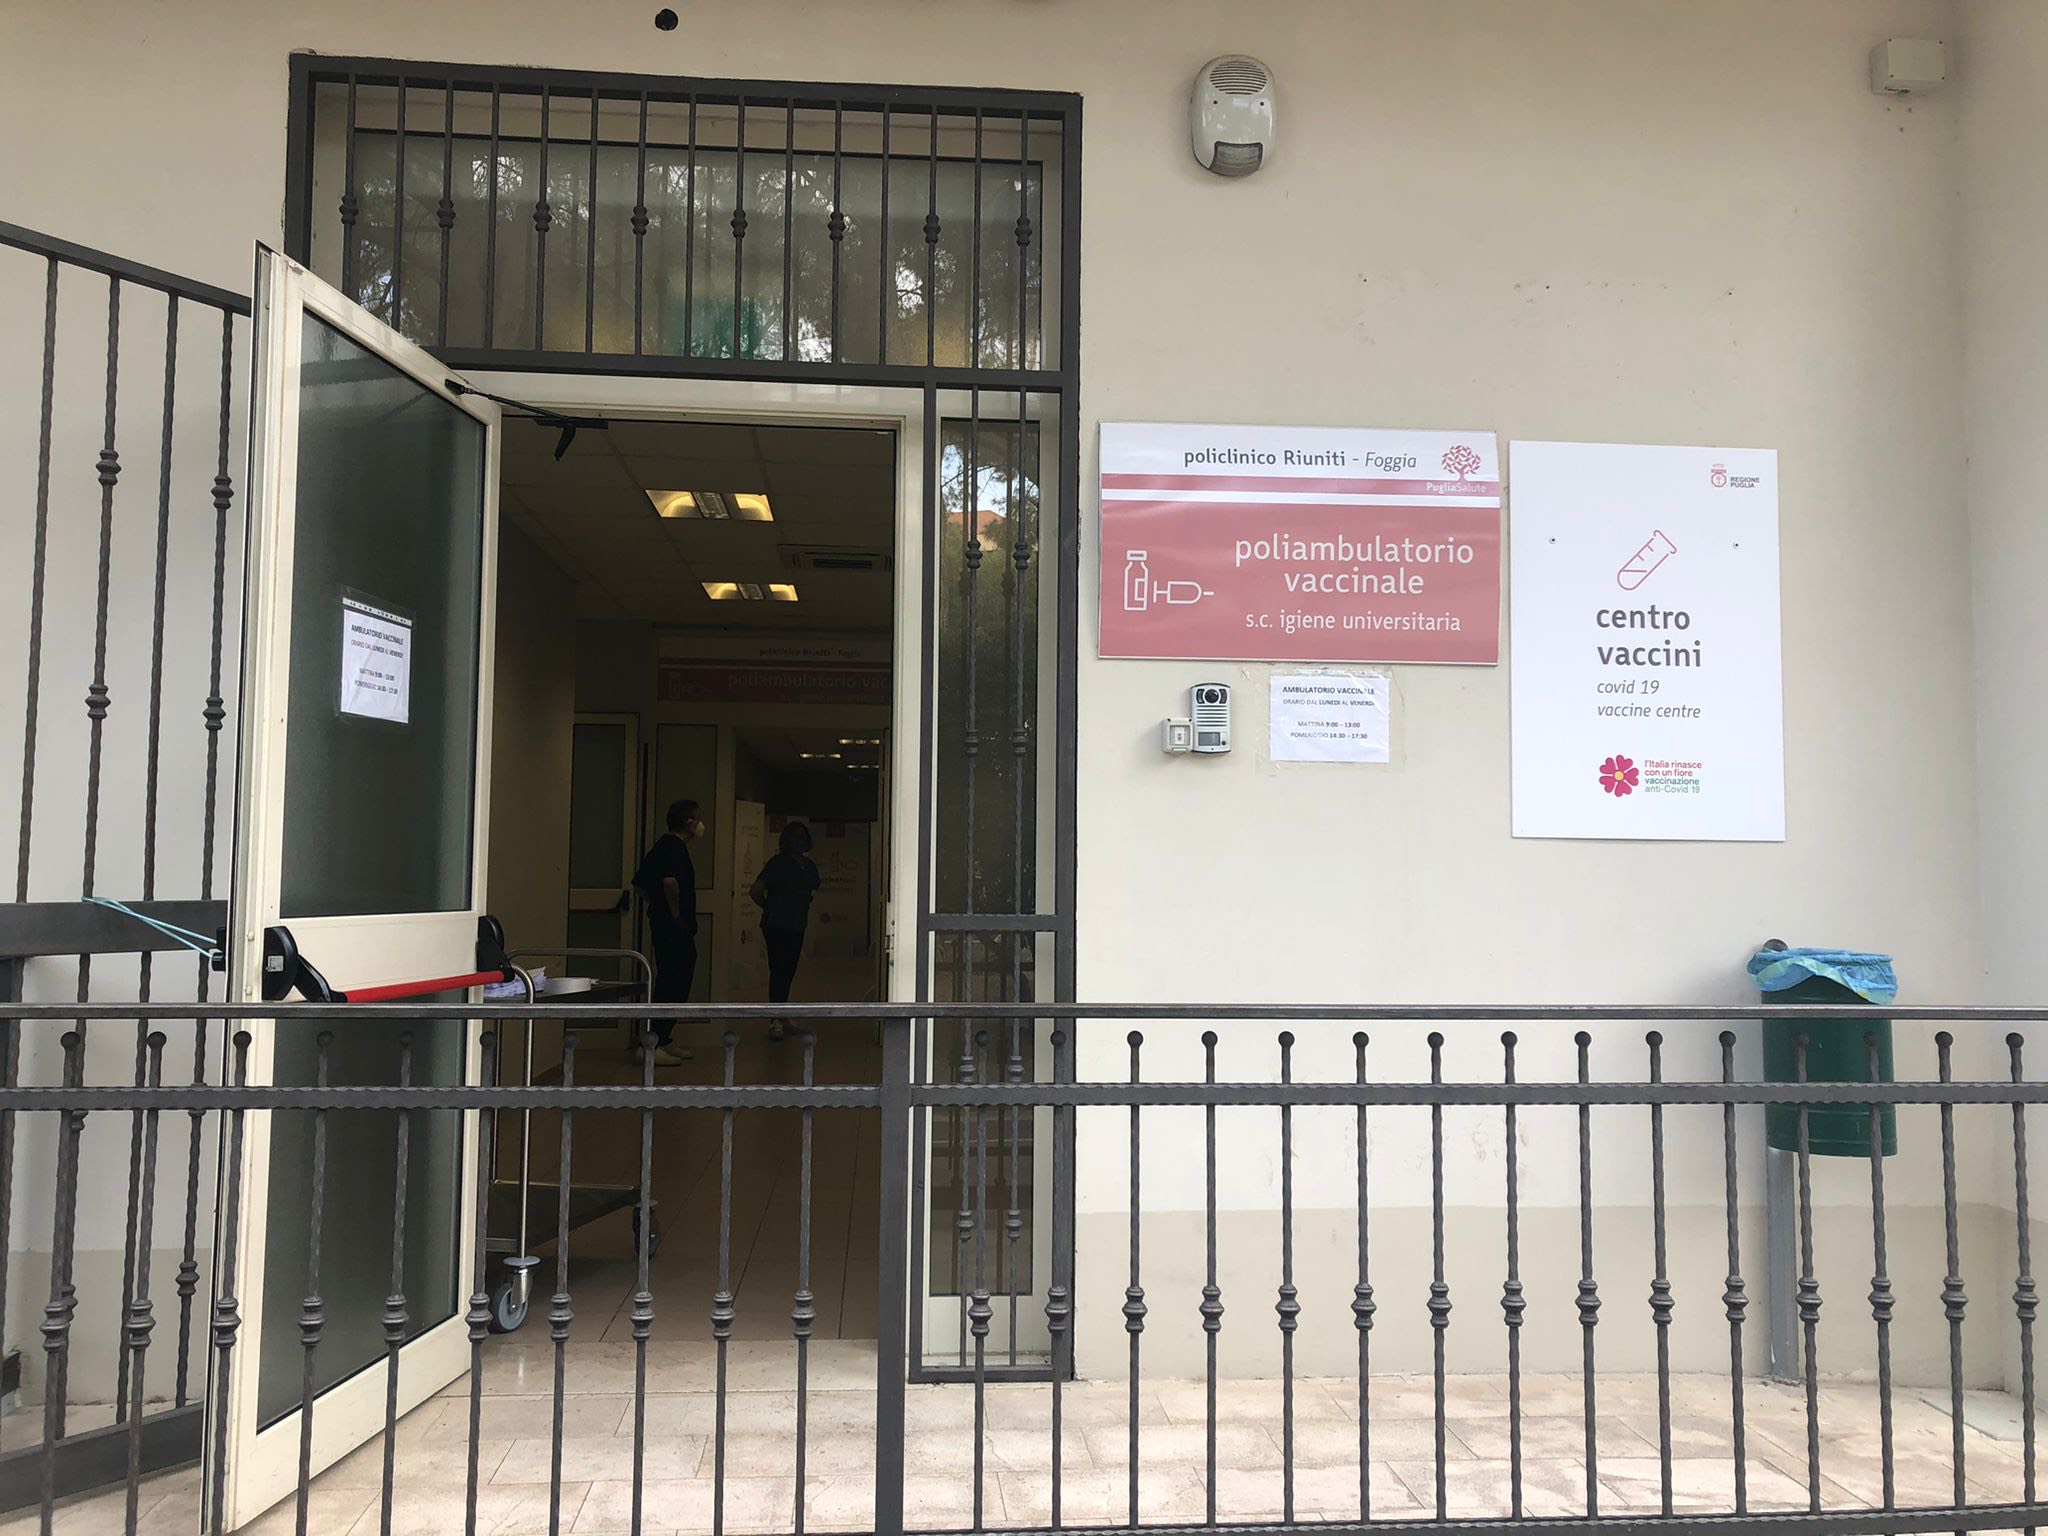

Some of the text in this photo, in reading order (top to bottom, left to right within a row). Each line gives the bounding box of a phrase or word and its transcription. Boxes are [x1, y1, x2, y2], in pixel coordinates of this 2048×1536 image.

[1184, 448, 1276, 467] policlinico
[1284, 450, 1345, 466] Riuniti
[1365, 451, 1417, 472] Foggia
[1426, 482, 1487, 494] PugliaSalute
[1235, 533, 1474, 567] poliambulatorio
[1284, 566, 1424, 594] vaccinale
[1245, 609, 1461, 634] s.c. igiene universitaria
[1596, 604, 1690, 630] centro
[351, 624, 382, 639] AMBULATORIO
[1597, 639, 1701, 667] vaccini
[728, 672, 857, 688] poliambulatorio
[1597, 680, 1660, 694] covid 19
[1282, 686, 1375, 695] AMBULATORIO VACCINLE
[1597, 702, 1701, 718] vaccine centre
[1671, 760, 1702, 769] rinasce
[1674, 769, 1693, 777] fiore
[1644, 777, 1700, 786] vaccinazione
[1644, 785, 1701, 794] anti-Covid 19
